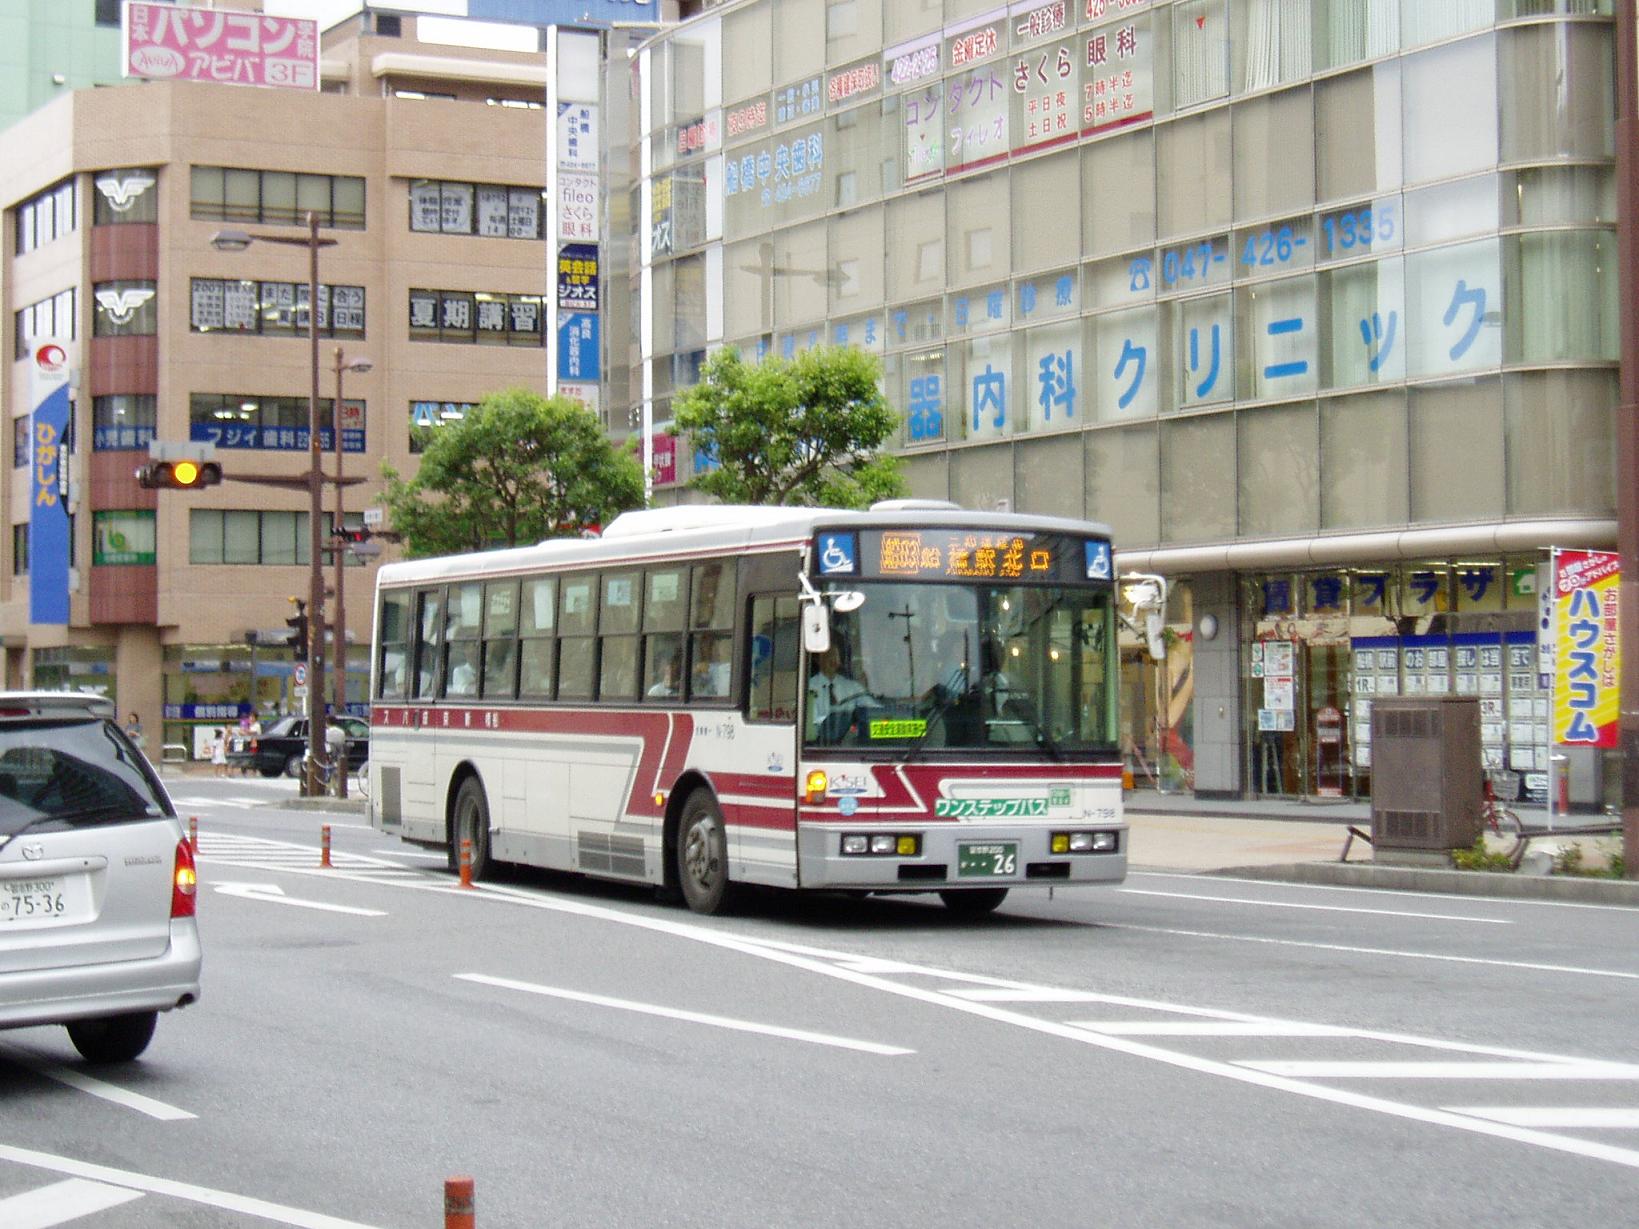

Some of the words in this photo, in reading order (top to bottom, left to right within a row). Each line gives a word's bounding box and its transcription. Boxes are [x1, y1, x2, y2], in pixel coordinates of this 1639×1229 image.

[133, 7, 148, 42] 日本
[152, 8, 297, 54] パソコン
[189, 51, 259, 82] アビバ
[271, 63, 308, 83] 3F
[563, 188, 594, 204] fileo
[562, 205, 593, 220] さくら
[559, 285, 596, 299] ジオス
[411, 298, 537, 332] 夏期講習
[36, 423, 56, 507] ひがしん
[1563, 588, 1601, 742] ハウスコム
[937, 799, 1048, 816] ワンステップバス
[993, 854, 1016, 875] 26
[12, 893, 65, 916] 75-36
